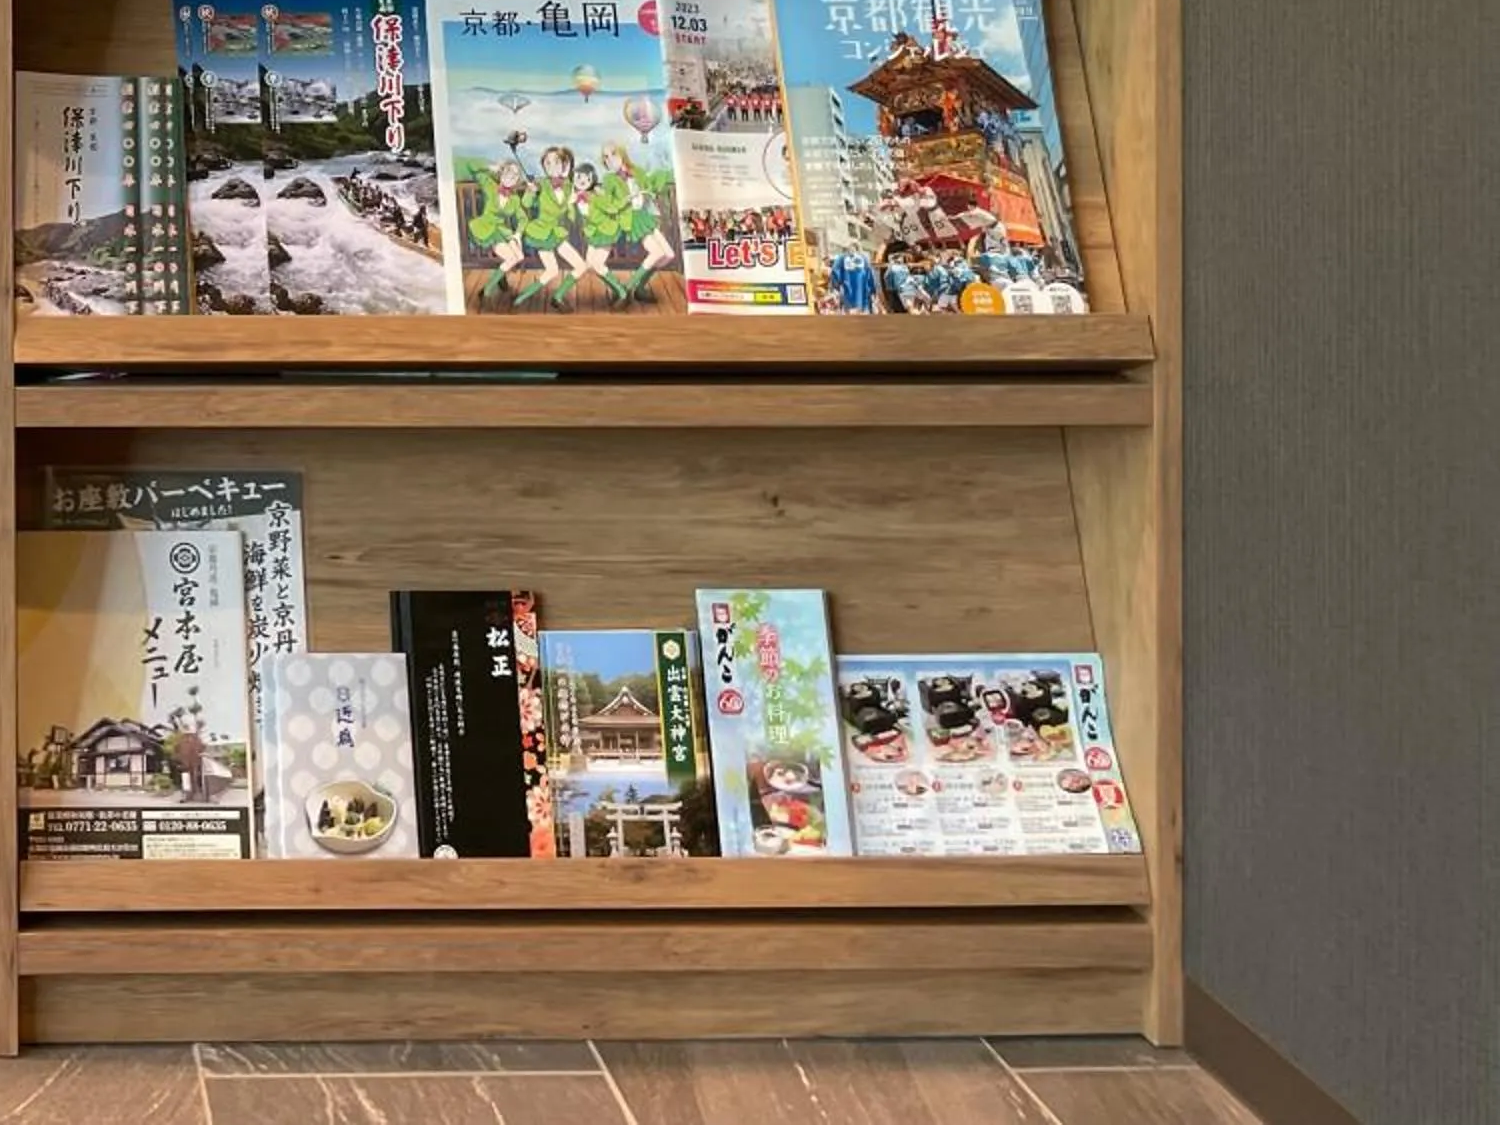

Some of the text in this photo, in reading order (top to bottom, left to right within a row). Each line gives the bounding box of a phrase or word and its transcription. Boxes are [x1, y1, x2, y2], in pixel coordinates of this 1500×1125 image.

[459, 0, 621, 39] 京都・亀岡
[671, 15, 708, 32] 12.03
[675, 33, 706, 45] START
[371, 13, 405, 154] 保津川下り
[61, 105, 85, 225] 保津川下り
[707, 238, 779, 270] Let's
[52, 476, 287, 513] お座敷バーベキュー
[171, 576, 203, 674] 宮本屋
[141, 615, 170, 709] メニュー
[485, 626, 513, 677] 松正
[666, 665, 687, 763] 出雲大神宮
